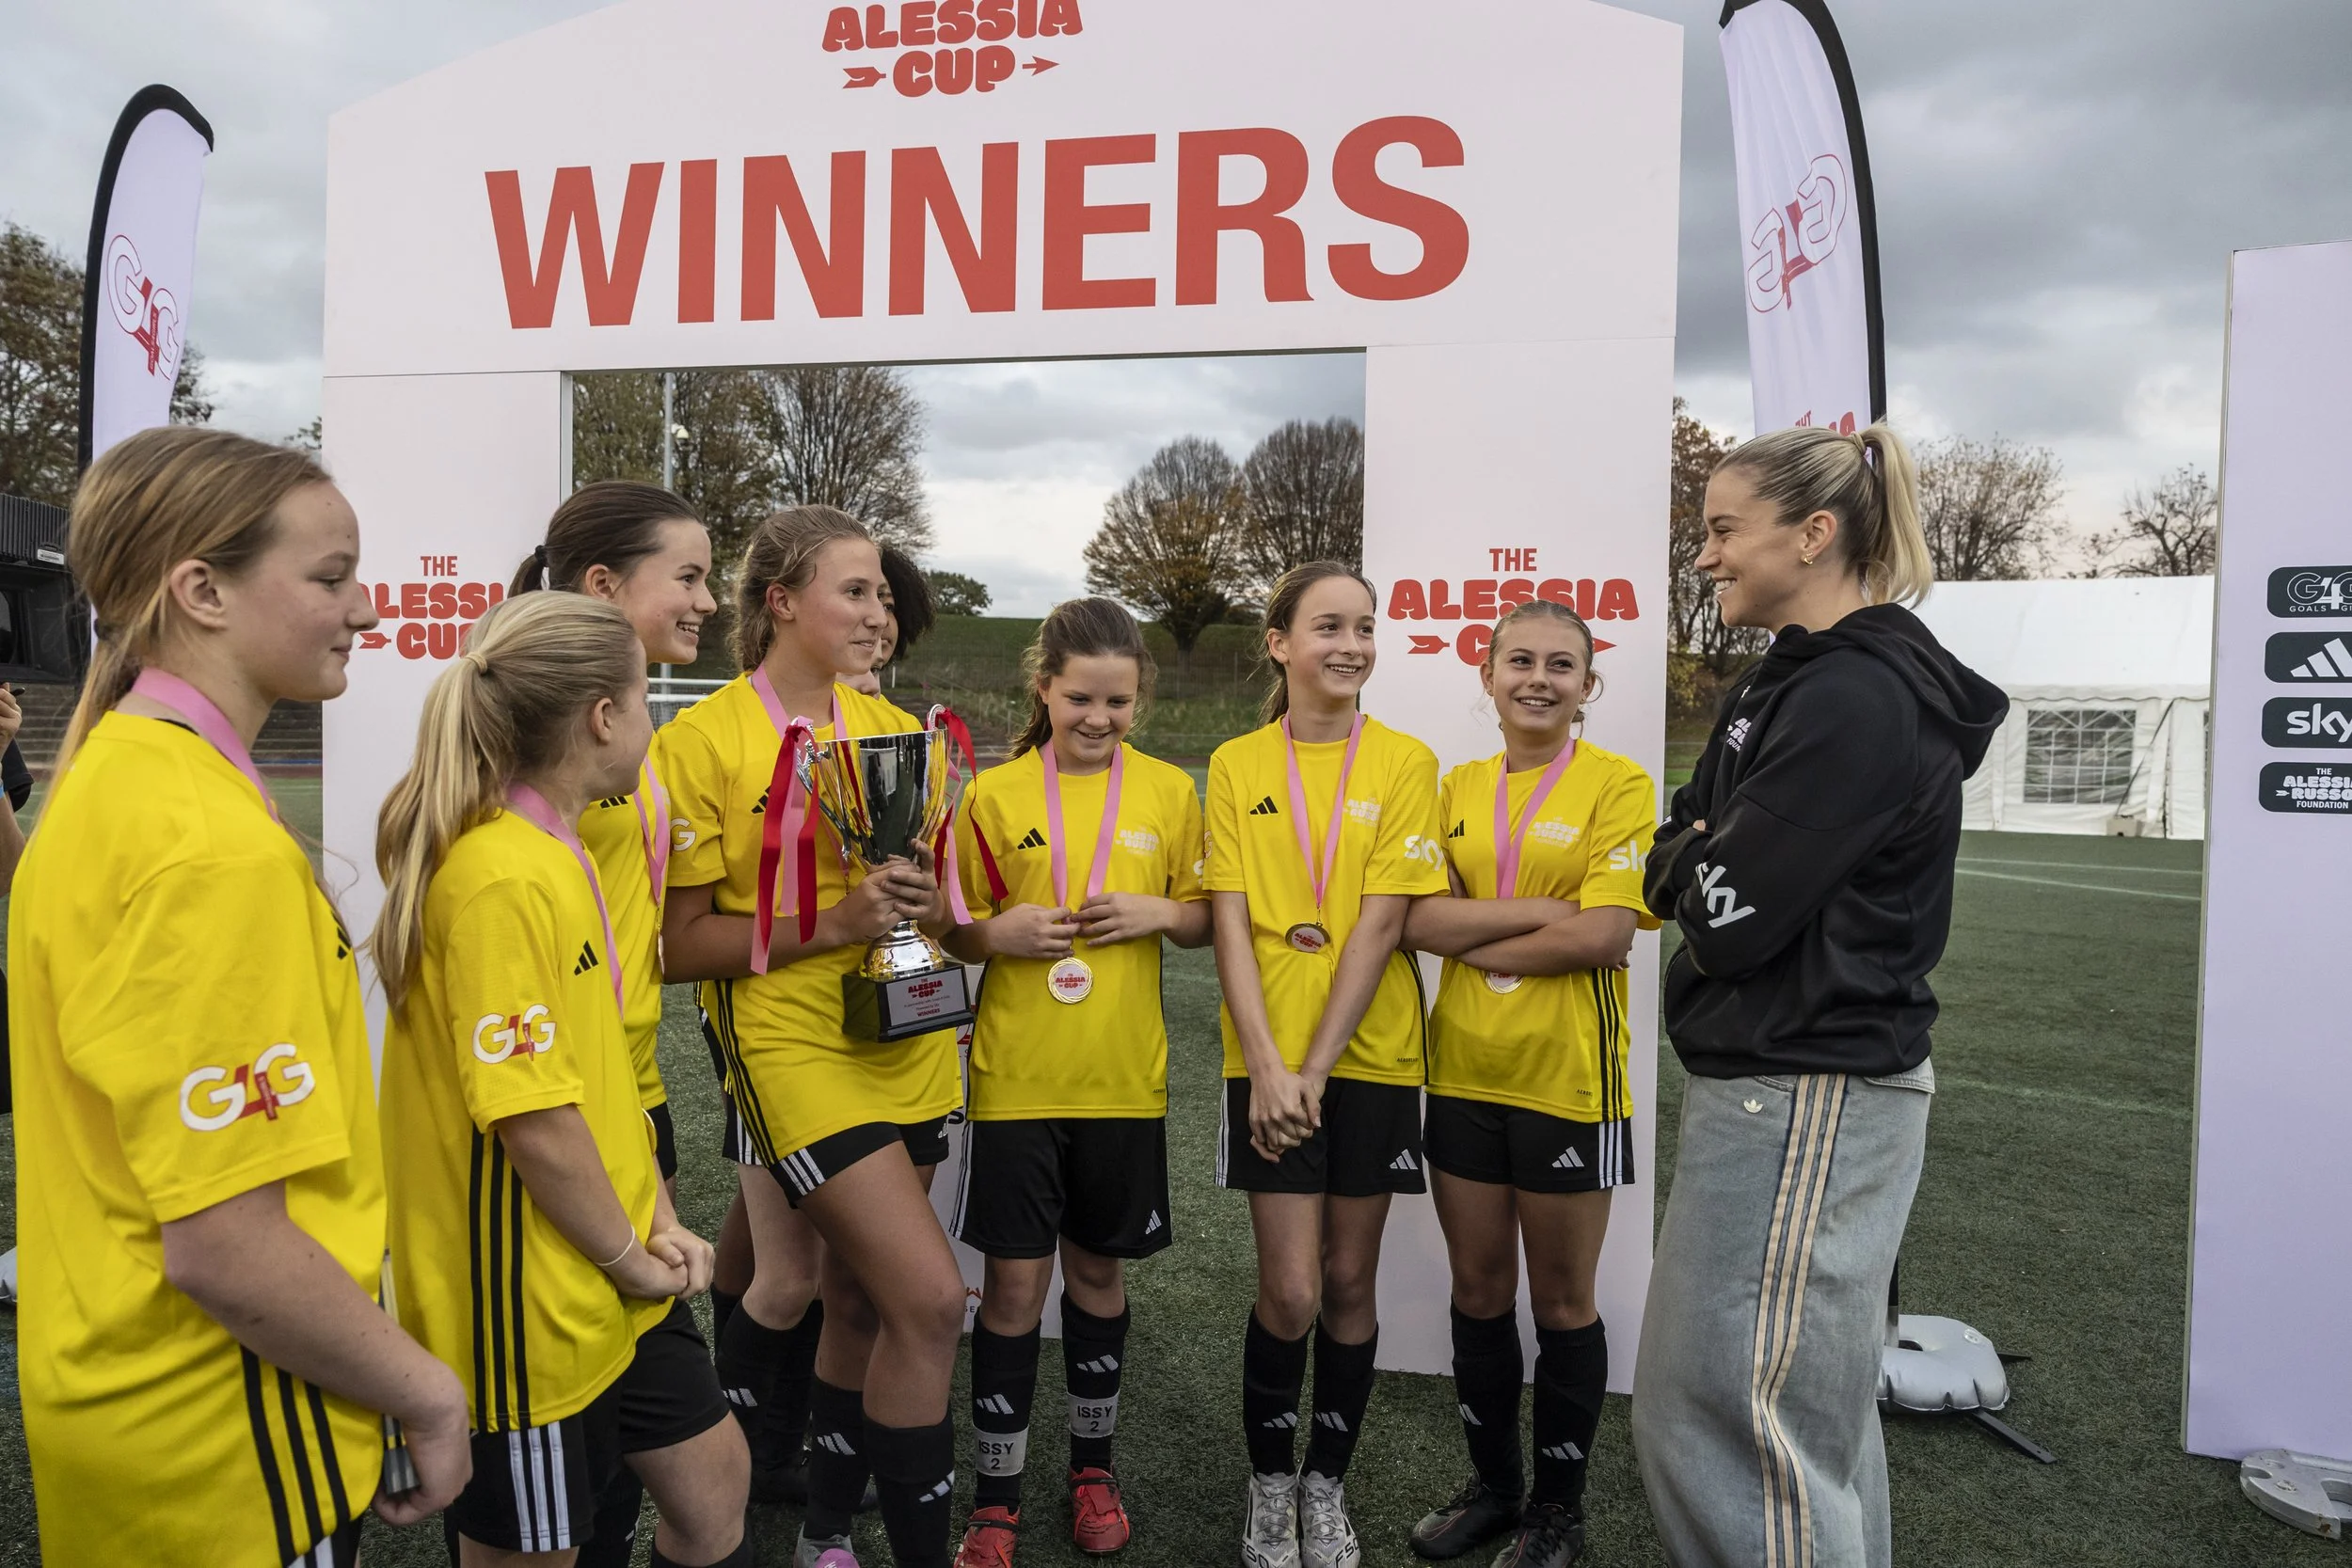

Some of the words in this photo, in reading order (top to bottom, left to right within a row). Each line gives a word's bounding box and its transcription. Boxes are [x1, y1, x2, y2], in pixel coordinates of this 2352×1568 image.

[821, 0, 1084, 53] ALESSIA
[892, 44, 1016, 98] CUP
[484, 115, 1470, 330] WINNERS
[420, 555, 458, 577] THE
[1488, 547, 1538, 572] THE
[359, 581, 505, 620] LESSI
[2286, 703, 2352, 743] sky
[2315, 768, 2332, 776] THE
[2282, 775, 2352, 789] ALESSI
[2291, 787, 2352, 801] RUSSO
[2296, 800, 2349, 810] FOUNDATION
[1608, 839, 1648, 875] sk
[1076, 1404, 1113, 1419] ISSY
[1089, 1420, 1100, 1433] 2
[978, 1439, 1014, 1455] ISSY
[991, 1458, 1001, 1470] 2
